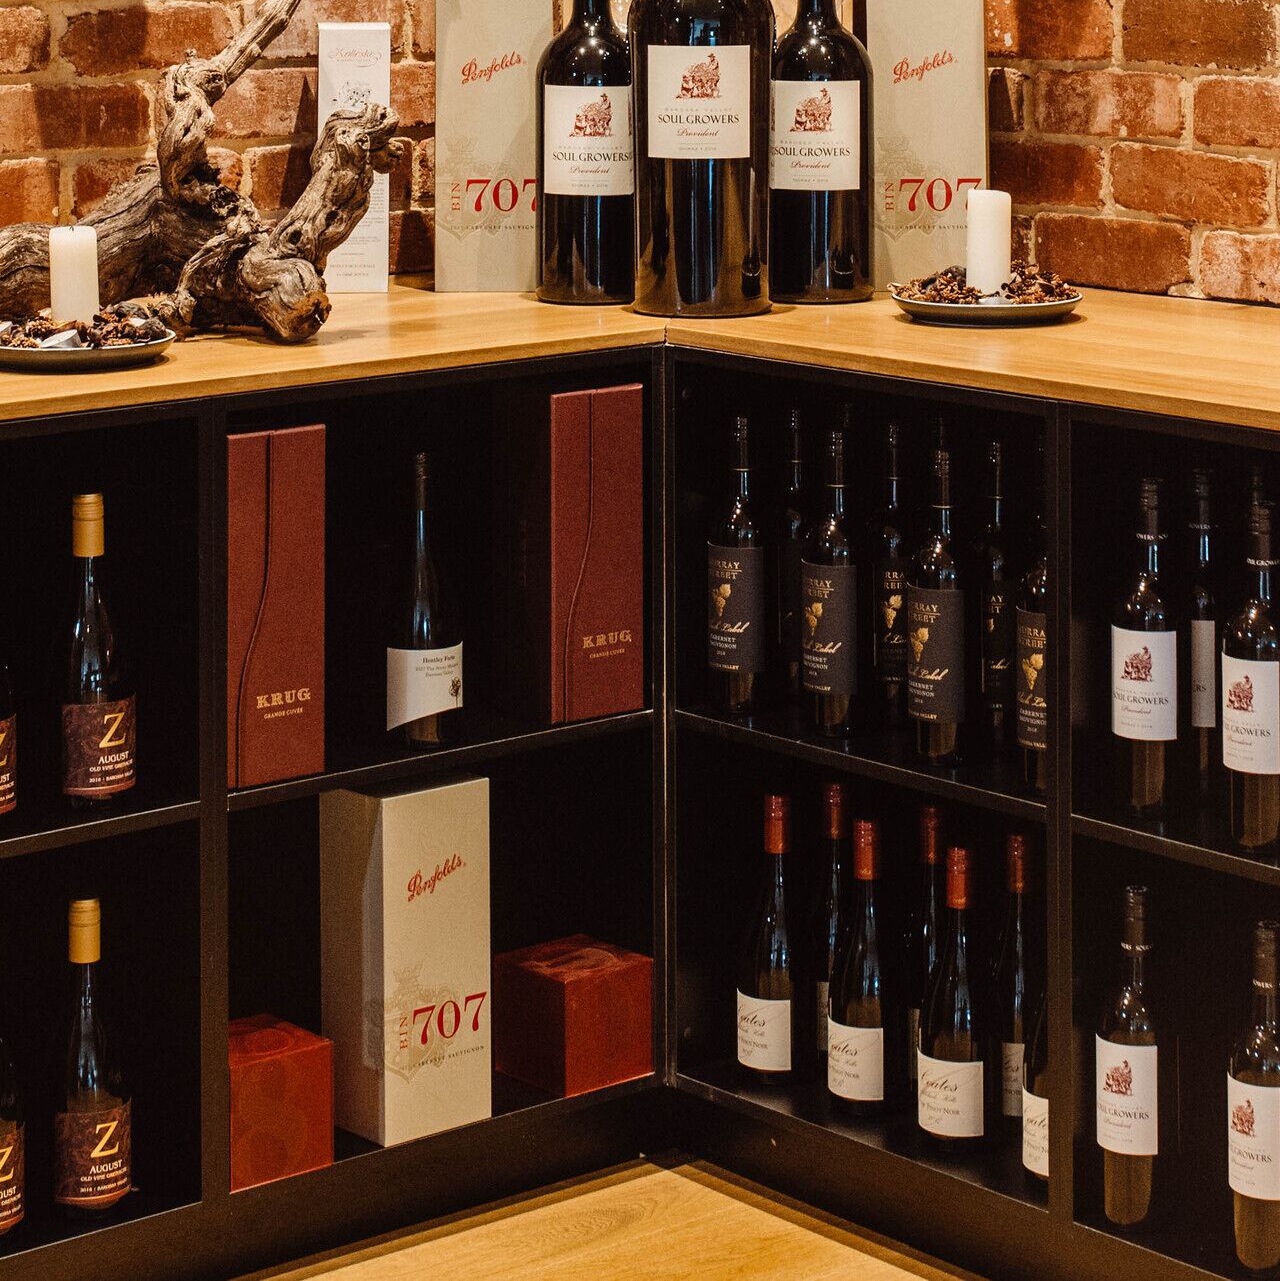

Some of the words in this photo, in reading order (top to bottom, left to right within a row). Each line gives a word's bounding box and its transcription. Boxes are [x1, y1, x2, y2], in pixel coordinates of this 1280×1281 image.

[461, 51, 523, 84] Penfolds
[893, 50, 954, 84] Penfolds
[658, 114, 684, 124] SOUL
[686, 114, 739, 124] GROWERS
[676, 128, 719, 137] Provident
[552, 151, 577, 161] SOUL
[578, 151, 629, 162] GROWERS
[775, 146, 798, 156] SOUL
[799, 146, 851, 157] GROWERS
[570, 165, 610, 175] Provident
[790, 160, 831, 169] Provident
[451, 181, 461, 211] BIN
[885, 181, 894, 211] BIN
[582, 630, 632, 649] KRUG
[257, 687, 311, 709] KRUG
[1127, 694, 1169, 705] GROWERS
[99, 712, 126, 748] Z
[1230, 725, 1271, 738] GROWERS
[98, 751, 129, 765] AUGUST
[407, 854, 463, 902] Penfolds
[399, 1015, 408, 1050] BIN
[412, 991, 487, 1046] 707
[1110, 1108, 1150, 1120] GROWERS
[90, 1120, 119, 1158] Z
[89, 1159, 122, 1175] AUGUST
